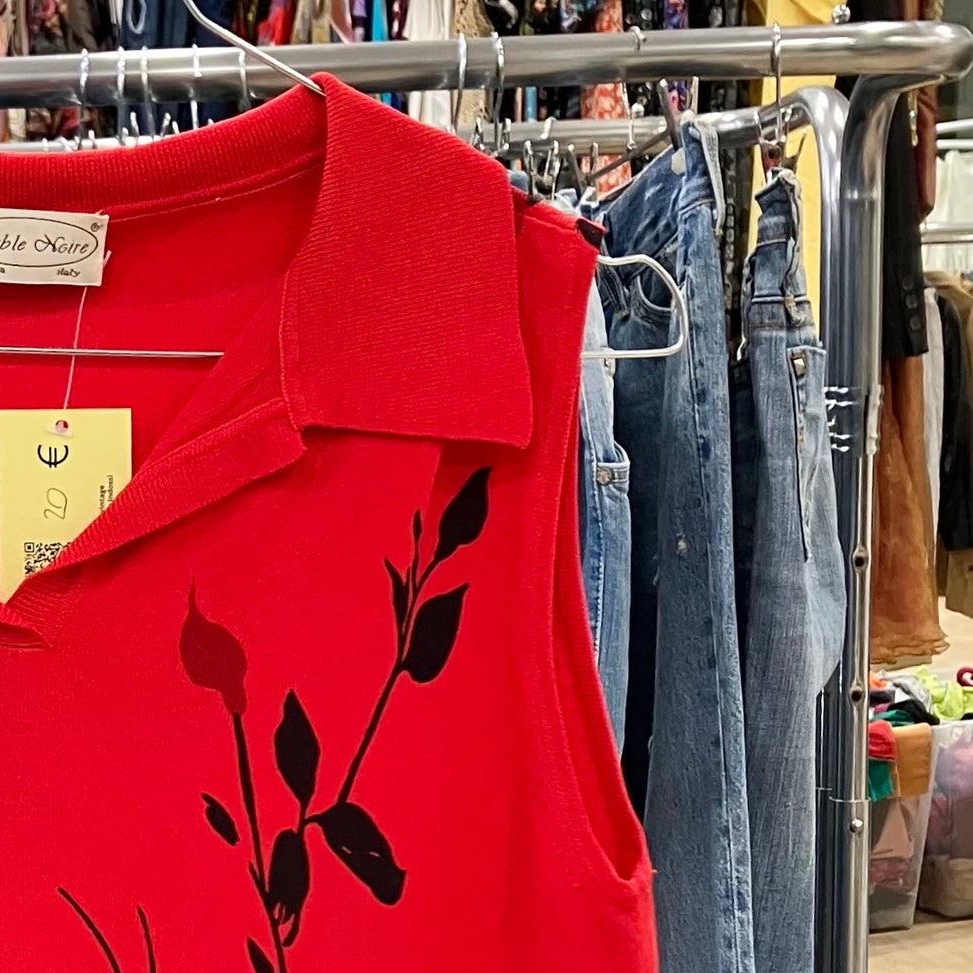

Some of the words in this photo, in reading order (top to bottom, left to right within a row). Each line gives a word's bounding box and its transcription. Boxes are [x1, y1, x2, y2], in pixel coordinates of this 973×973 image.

[34, 234, 90, 255] Noire
[56, 267, 81, 278] italy
[43, 487, 68, 520] 20
